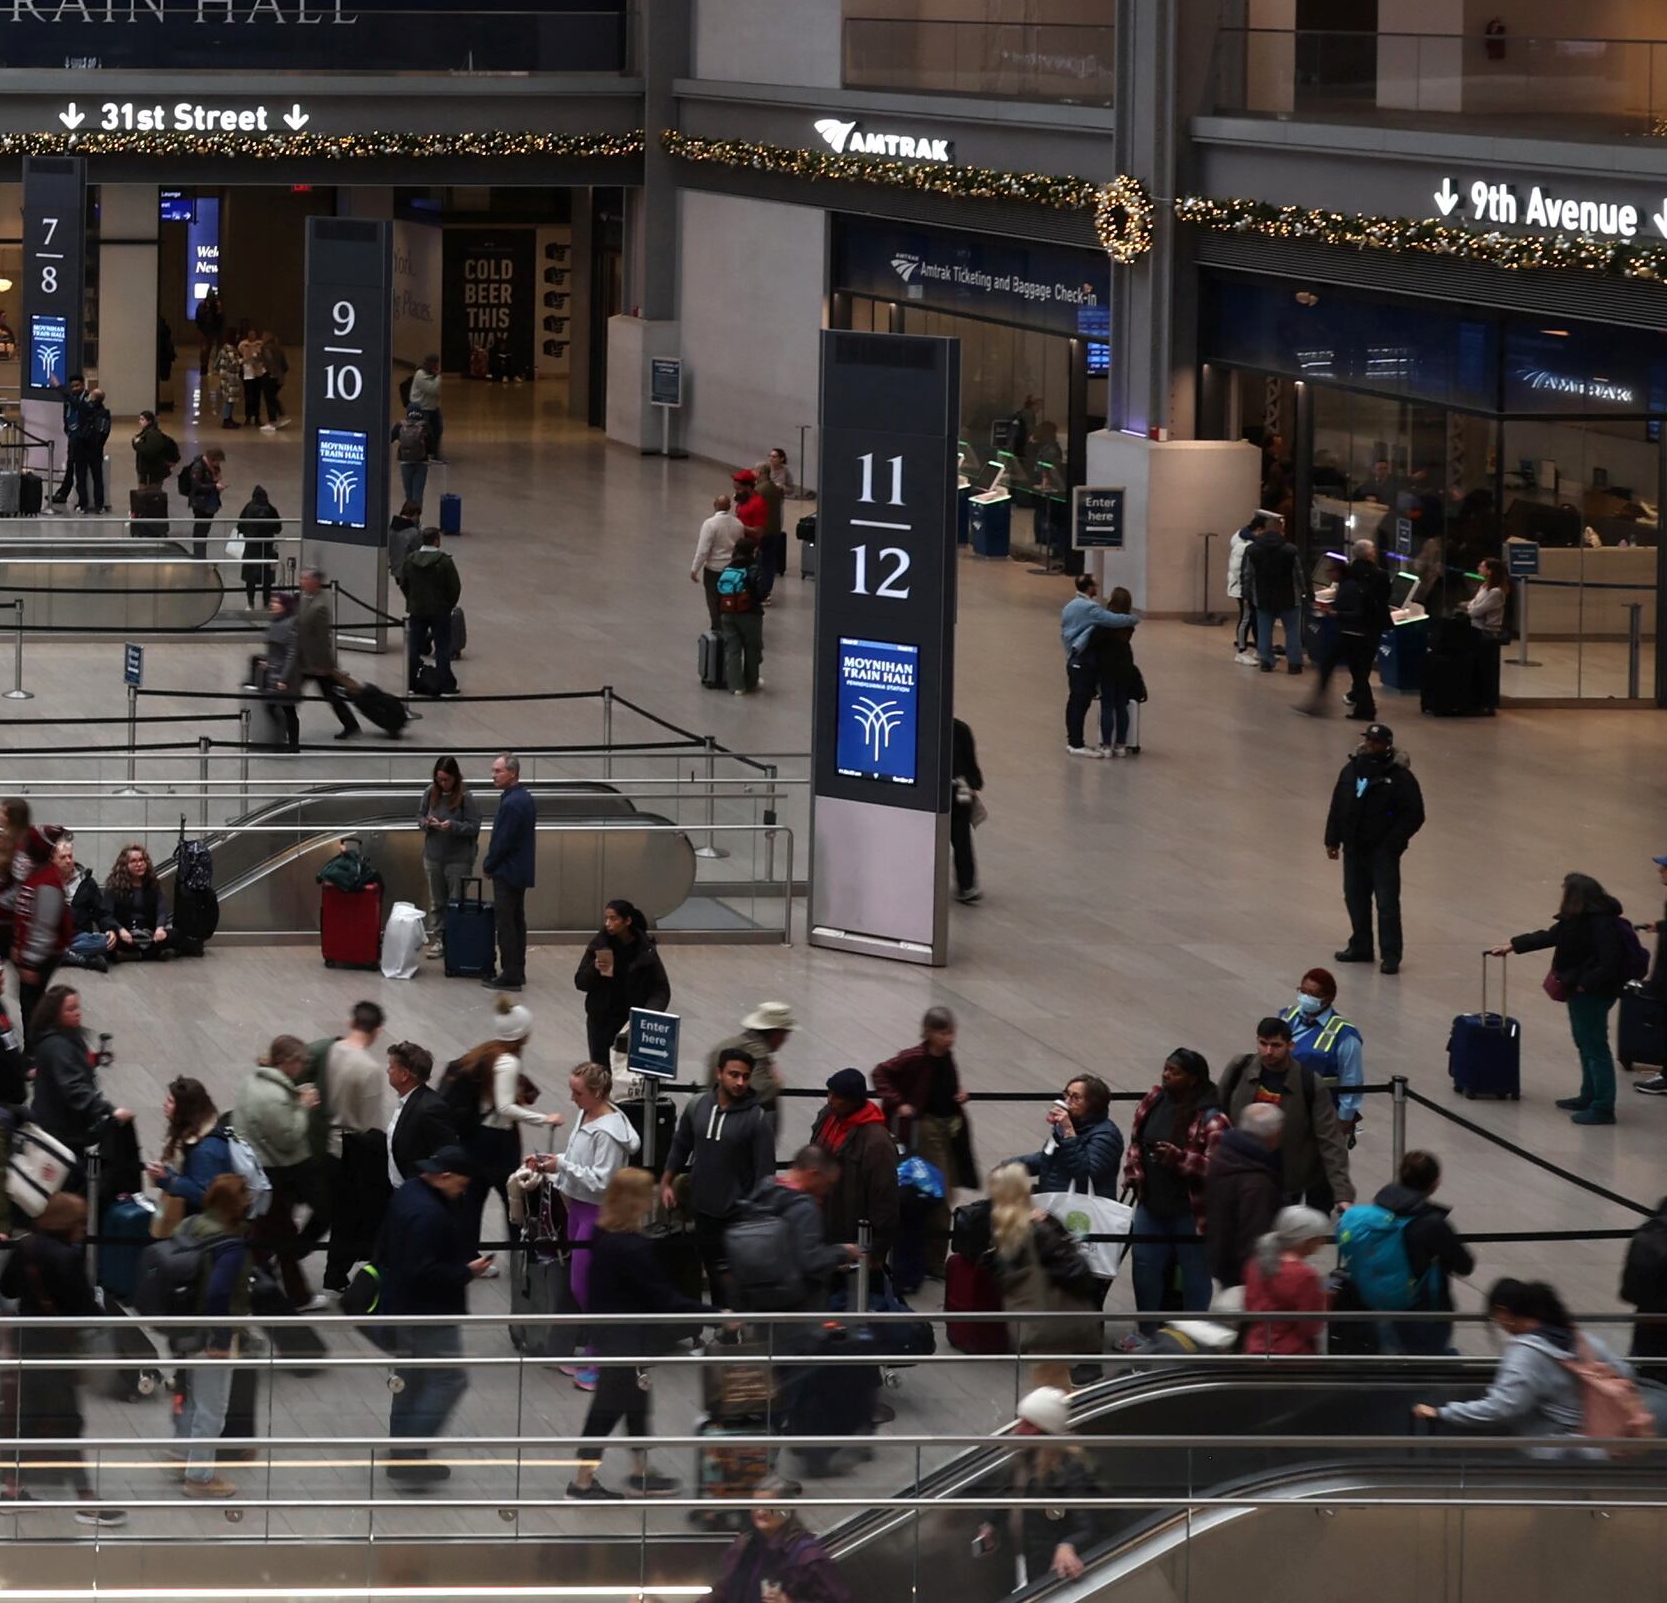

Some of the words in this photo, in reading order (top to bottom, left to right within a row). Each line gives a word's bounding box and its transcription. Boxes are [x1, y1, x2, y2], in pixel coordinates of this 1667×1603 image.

[100, 102, 166, 131] 31st
[173, 102, 268, 131] Street
[849, 131, 949, 162] AMTRAK
[1470, 181, 1518, 224] 9th
[1526, 186, 1638, 237] Avenue
[42, 217, 59, 246] 7
[41, 266, 58, 294] 8
[464, 259, 513, 280] COLD
[464, 283, 513, 304] BEER
[920, 261, 952, 282] Amtrak
[953, 265, 992, 292] Ticketing
[994, 274, 1011, 291] and
[1012, 276, 1053, 302] Baggage
[1054, 283, 1098, 307] Check-in
[332, 300, 356, 336] 9
[467, 307, 510, 328] THIS
[324, 364, 363, 401] 10
[320, 441, 364, 453] MOYNIHAN
[320, 449, 344, 459] TRAIN
[344, 451, 365, 461] HALL
[855, 452, 908, 507] 11
[1085, 497, 1117, 508] Enter
[1088, 510, 1115, 522] here
[849, 543, 911, 599] 12
[843, 655, 914, 675] MOYNIHAN
[842, 666, 881, 683] TRAIN
[882, 671, 915, 686] HALL
[640, 1018, 671, 1034] Enter
[641, 1031, 668, 1047] here
